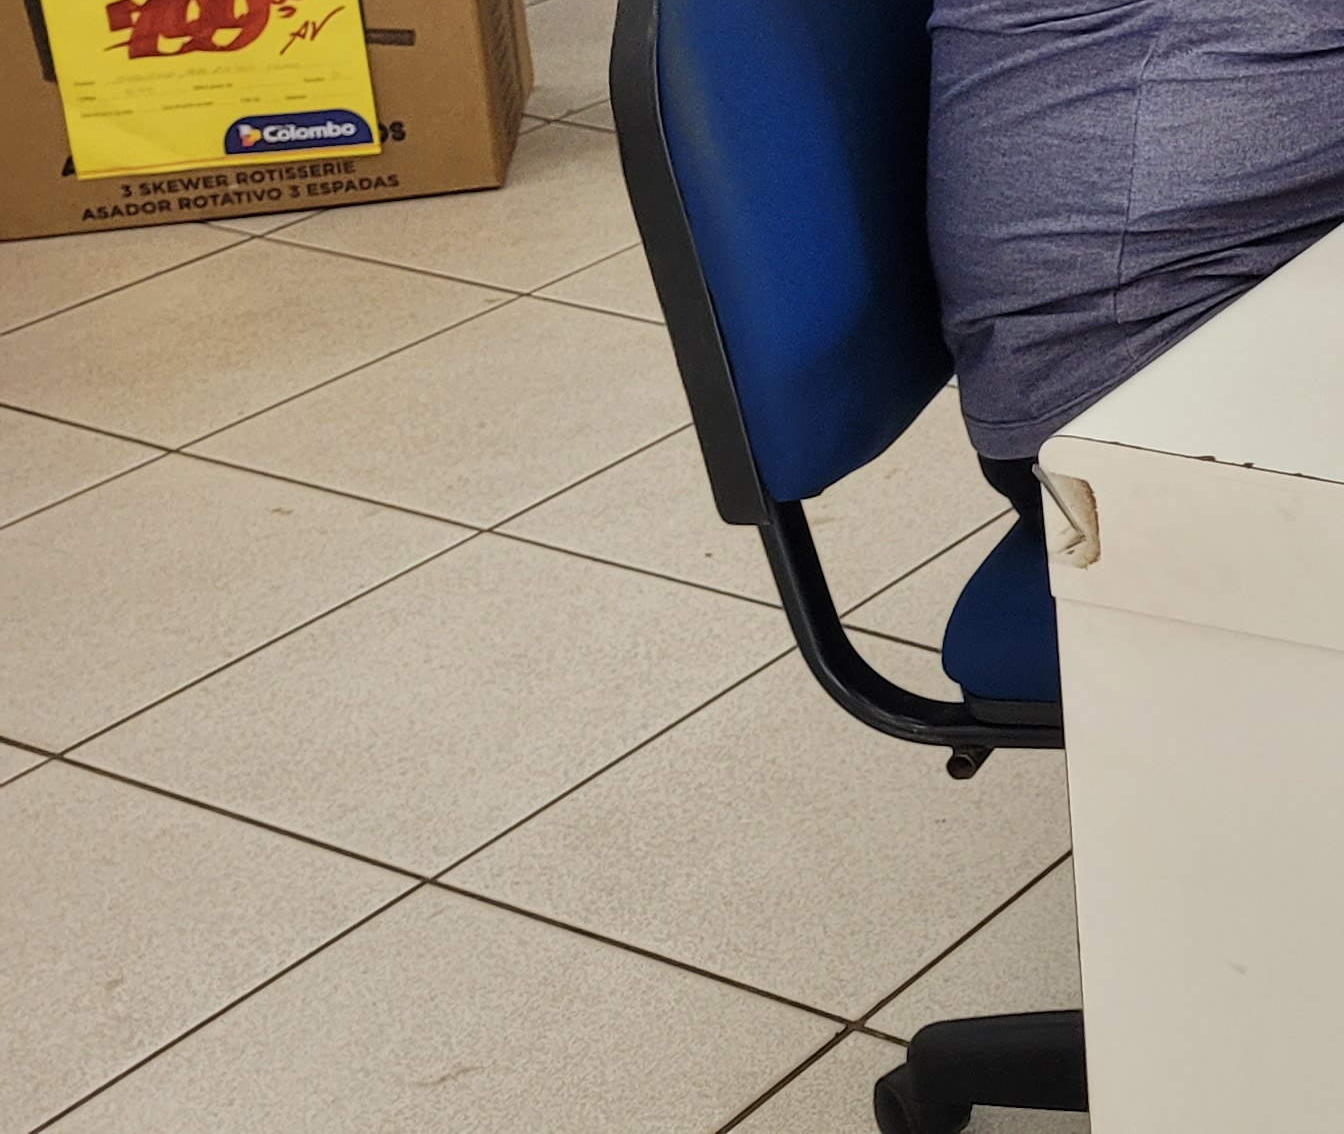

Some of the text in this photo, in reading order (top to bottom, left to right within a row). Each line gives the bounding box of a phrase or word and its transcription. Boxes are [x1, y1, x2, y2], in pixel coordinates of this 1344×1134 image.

[262, 122, 357, 144] Colombo
[82, 175, 399, 221] ASADOR ROTATIVO 3 ESPADAS
[121, 161, 356, 198] 3 SKEWER ROTISSERIE
